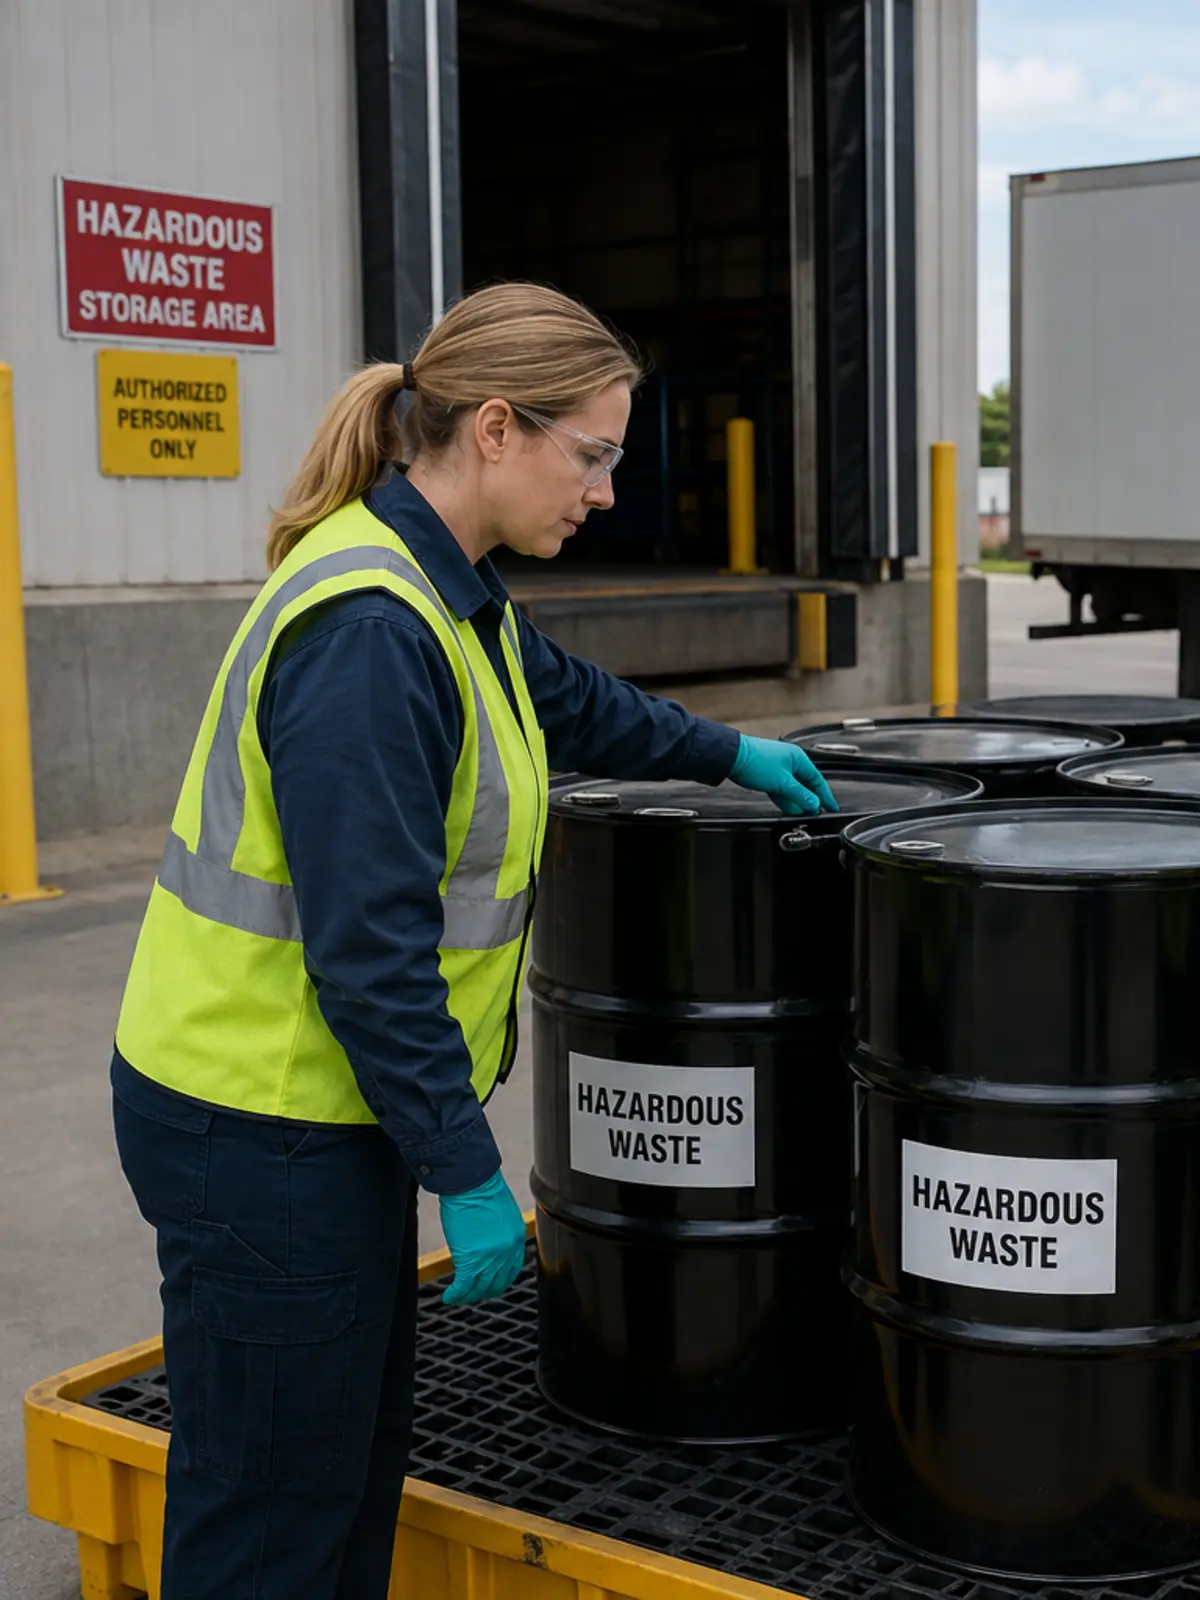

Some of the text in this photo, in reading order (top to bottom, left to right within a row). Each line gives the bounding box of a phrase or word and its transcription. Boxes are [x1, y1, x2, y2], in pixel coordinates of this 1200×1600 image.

[76, 198, 263, 254] HAZARDOUS
[121, 248, 225, 291] WASTE
[79, 290, 266, 333] STORAGE AREA
[114, 378, 227, 403] AUTHORIZED
[118, 408, 225, 433] PERSONNEL
[150, 439, 196, 460] ONLY
[577, 1082, 744, 1126] HAZARDOUS
[608, 1128, 702, 1165] WASTE
[912, 1174, 1105, 1226] HAZARDOUS
[949, 1226, 1058, 1269] WASTE
